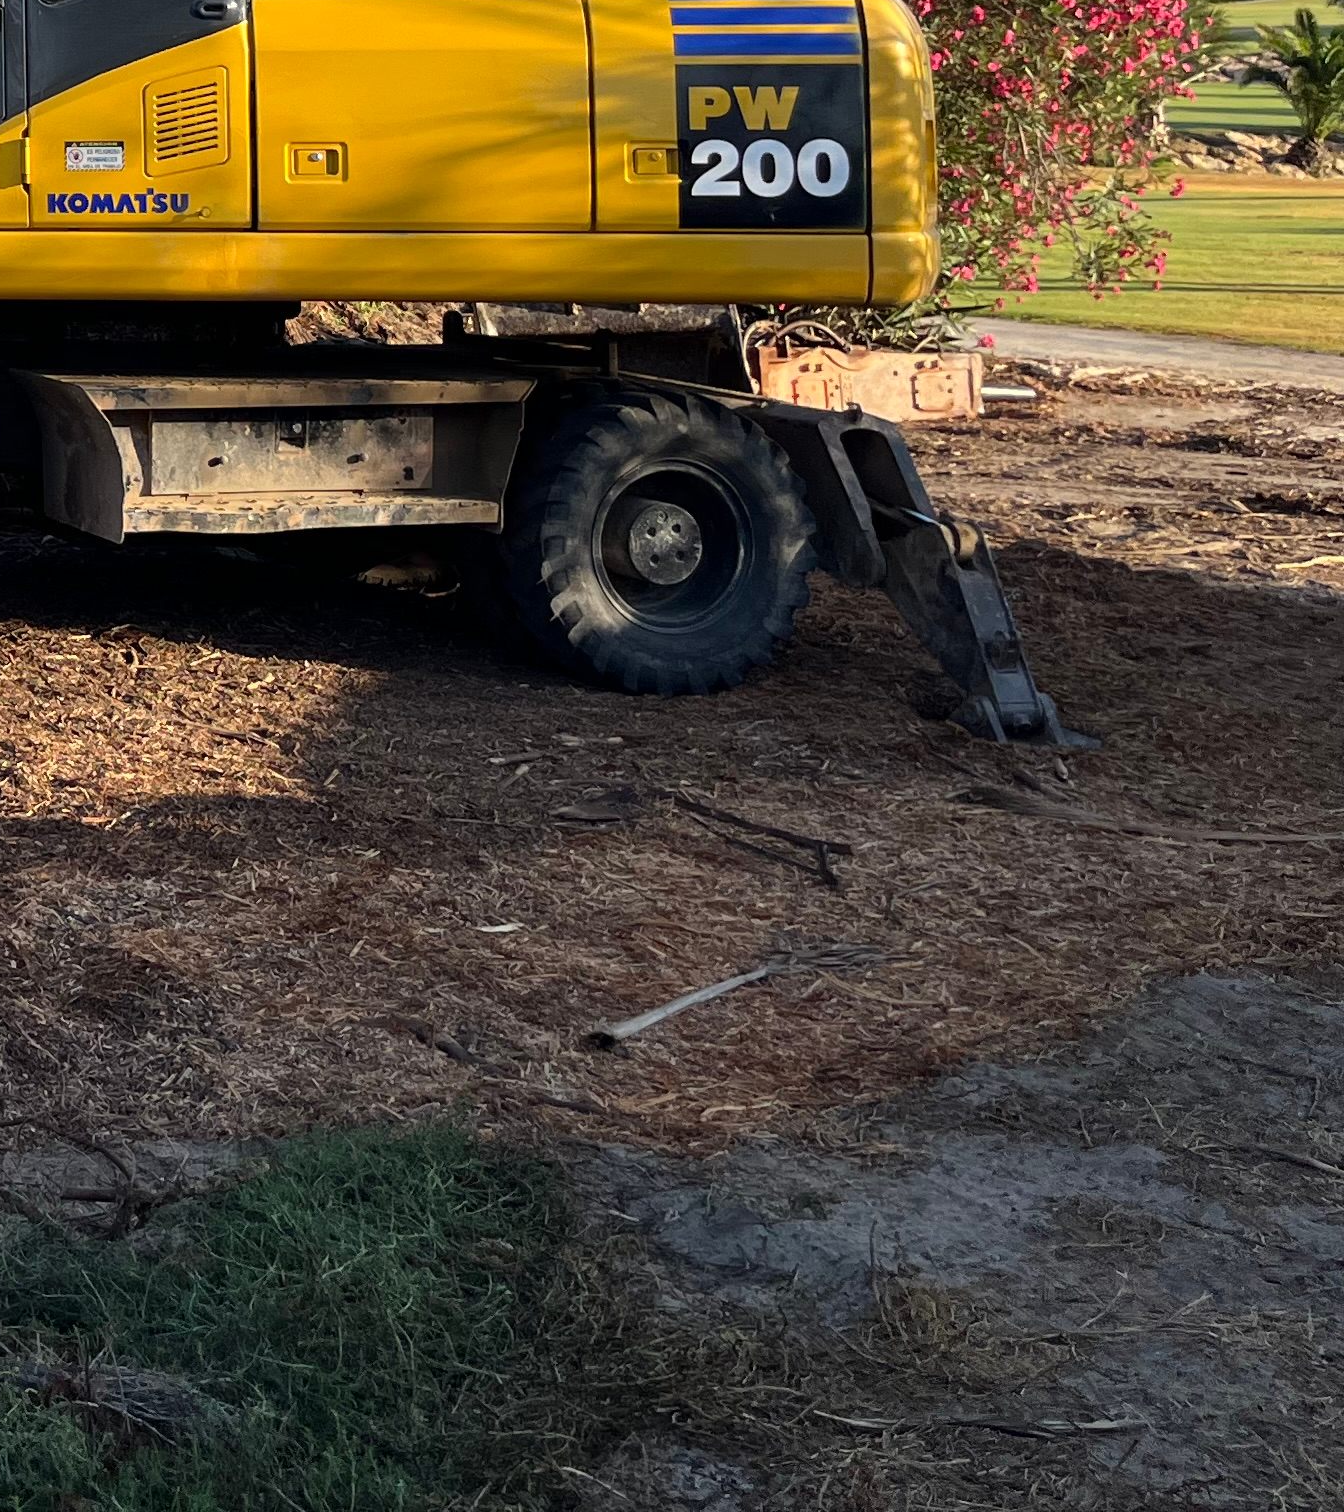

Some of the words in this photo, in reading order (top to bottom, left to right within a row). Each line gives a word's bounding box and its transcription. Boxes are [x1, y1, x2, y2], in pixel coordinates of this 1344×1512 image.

[688, 86, 800, 131] PW
[691, 138, 850, 198] 200
[47, 188, 190, 214] KOMATSU
